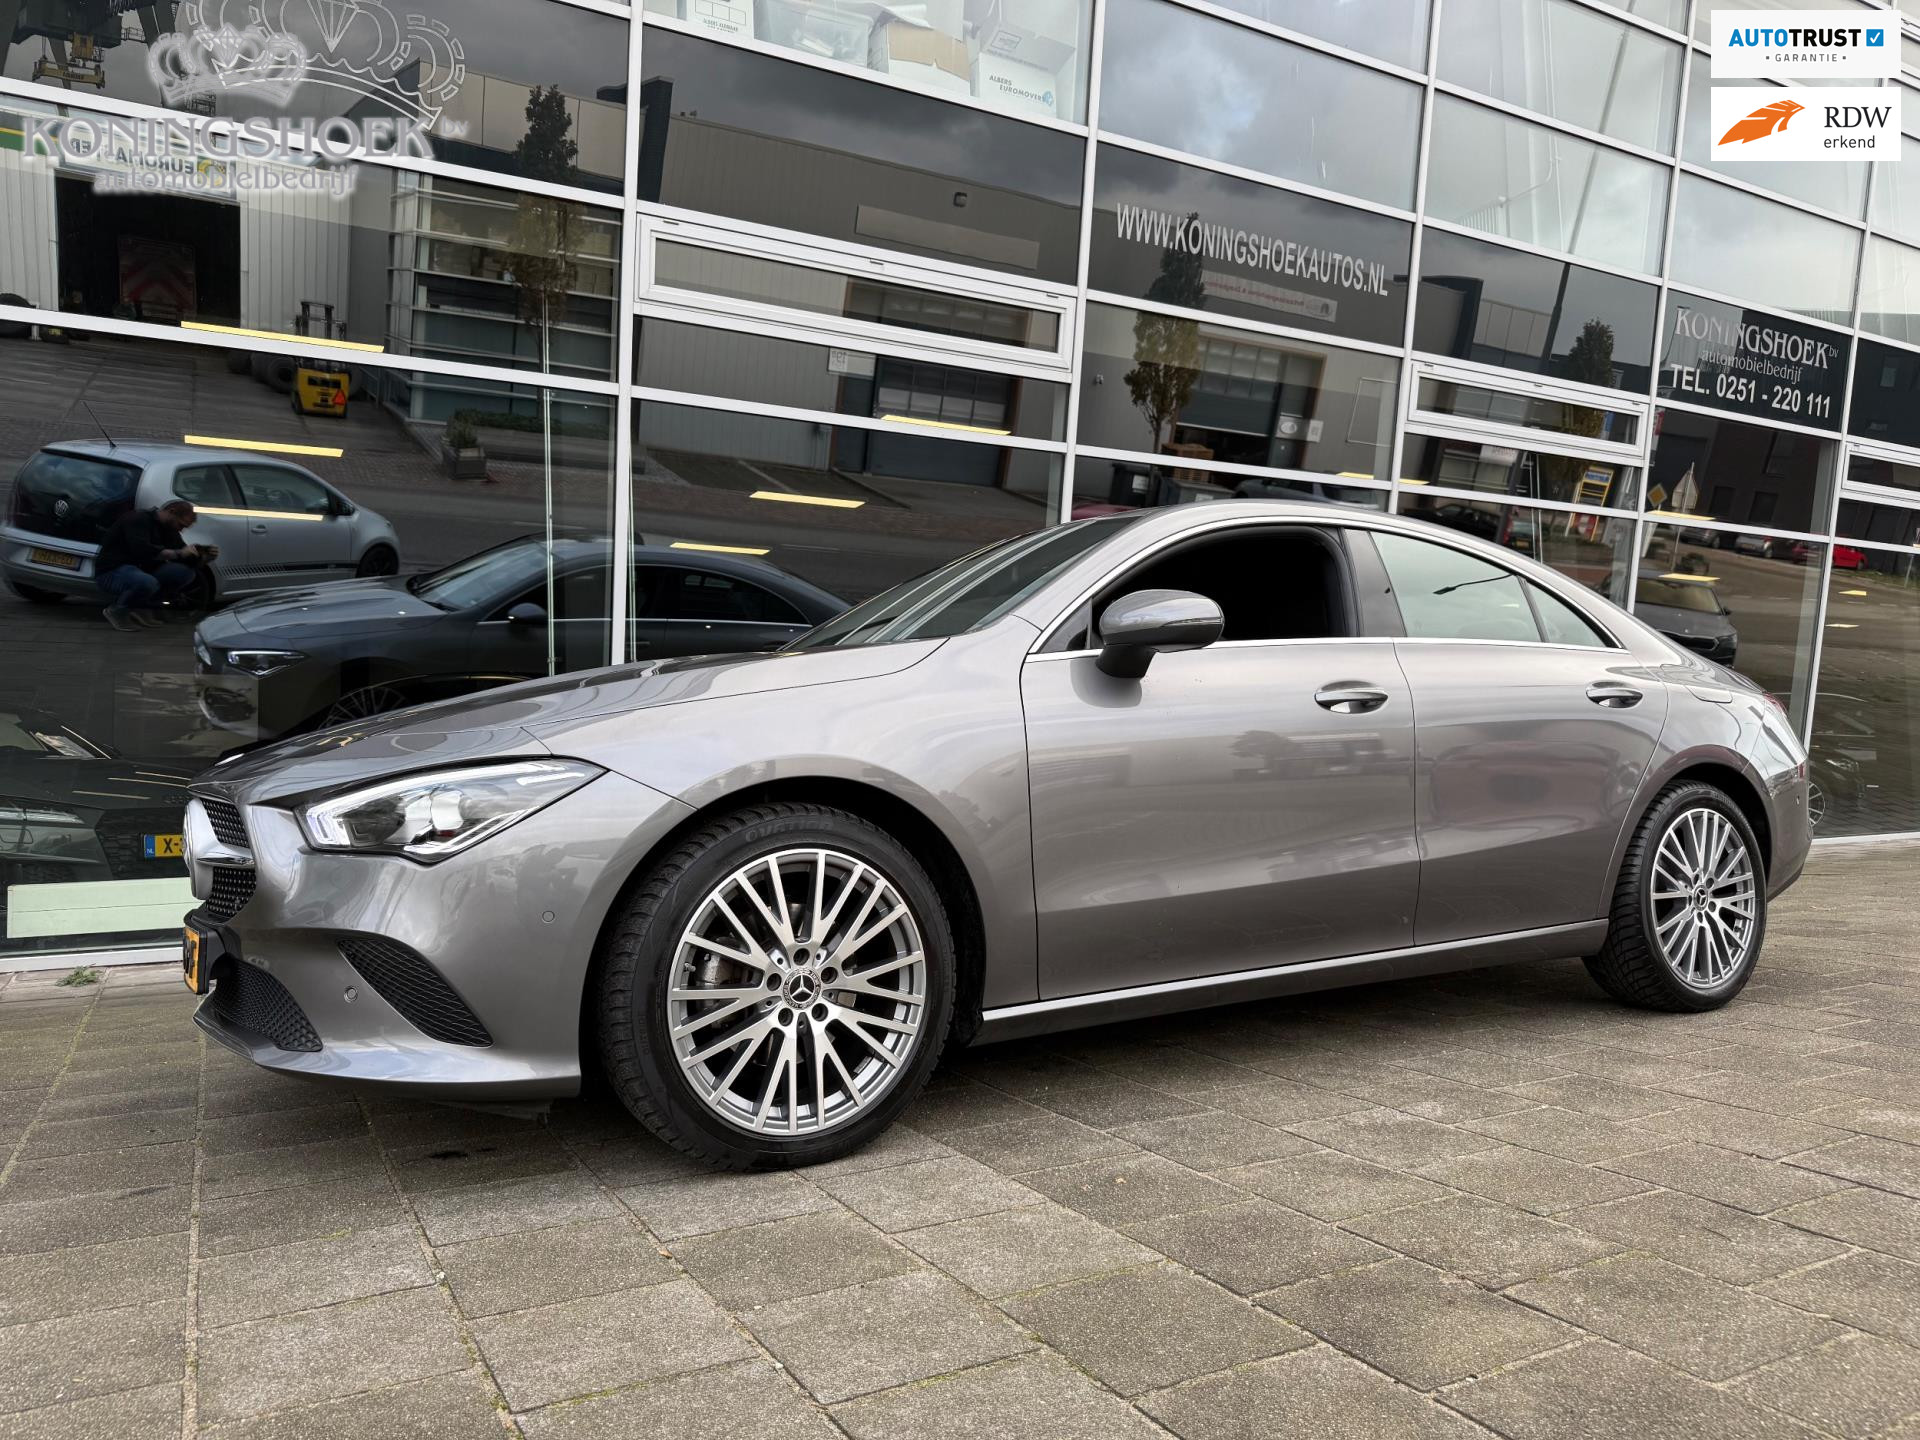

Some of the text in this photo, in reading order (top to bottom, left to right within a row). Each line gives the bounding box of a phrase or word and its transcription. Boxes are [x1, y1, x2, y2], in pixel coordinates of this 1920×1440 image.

[989, 74, 1013, 87] ALBERS
[1116, 202, 1388, 297] WWW.KONINGSHOEKAUTOS.NL
[1674, 307, 1829, 369] KONINGSHOEK
[1670, 363, 1710, 395] TEL.
[1716, 373, 1756, 403] 0251
[1771, 385, 1801, 413] 220
[1806, 392, 1831, 418] 111
[1701, 350, 1804, 385] automobielbedrijf
